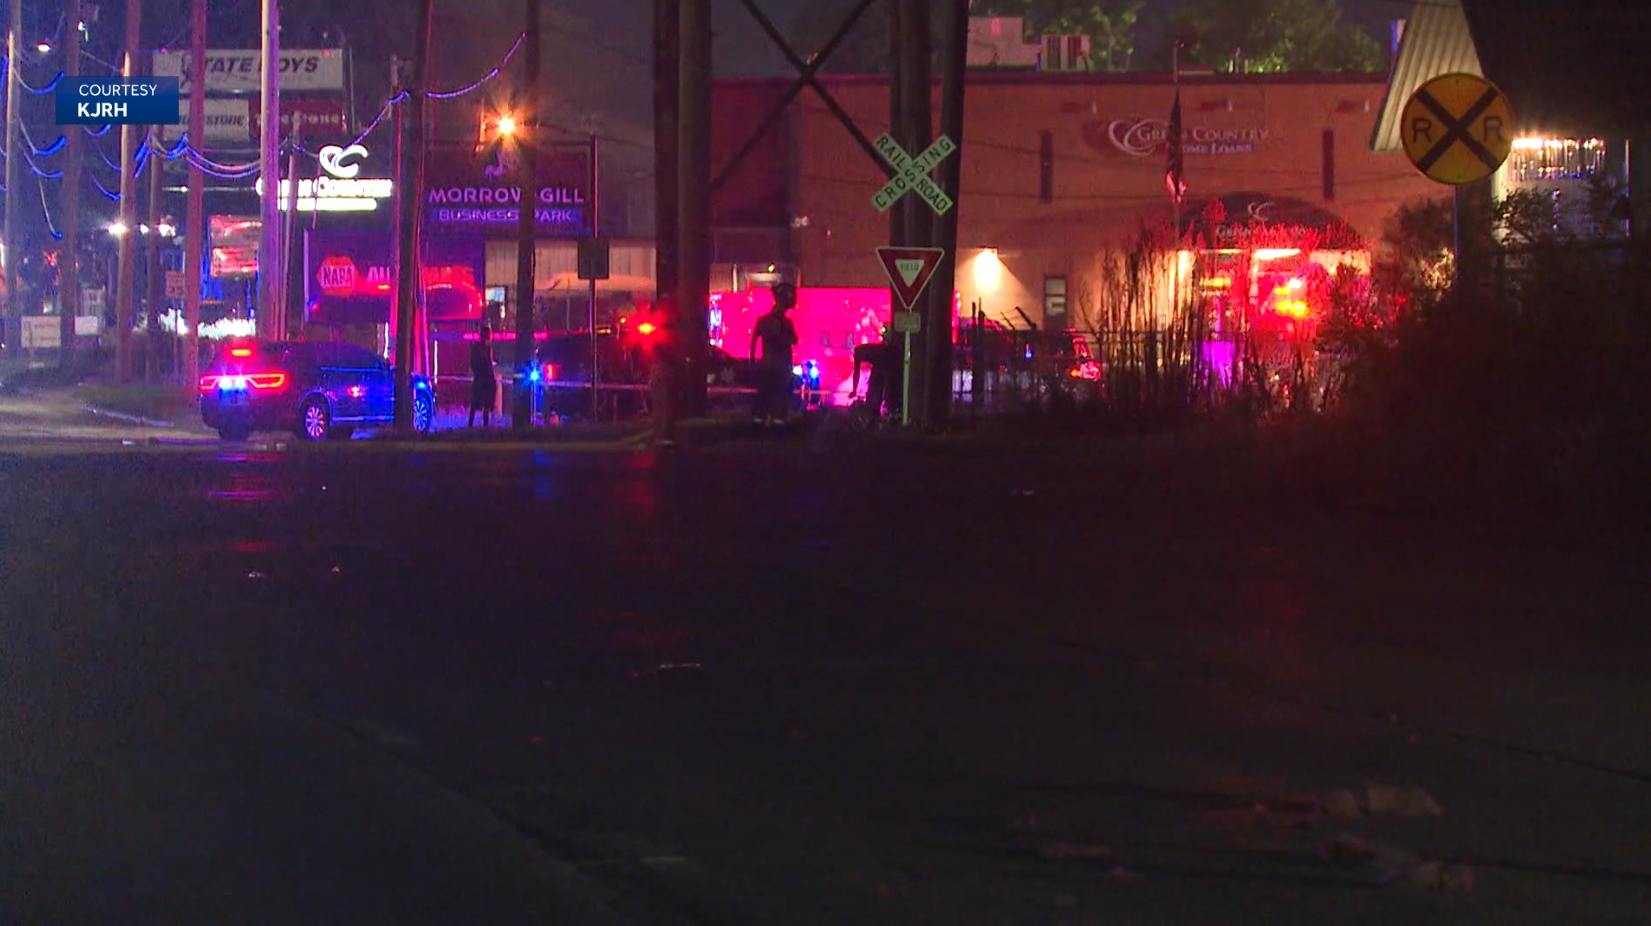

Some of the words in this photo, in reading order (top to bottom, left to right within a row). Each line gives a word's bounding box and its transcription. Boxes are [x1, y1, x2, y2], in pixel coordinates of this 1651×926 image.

[203, 56, 254, 74] TATE
[257, 56, 320, 73] OYS
[1193, 126, 1268, 142] COUNTRY
[1412, 118, 1432, 142] R
[1483, 116, 1503, 142] R
[875, 140, 951, 208] CROSSING
[876, 136, 906, 169] RAIL
[917, 178, 948, 211] ROAD
[540, 187, 584, 203] GILL
[439, 208, 519, 222] BUSINESS
[320, 266, 355, 288] NAPA
